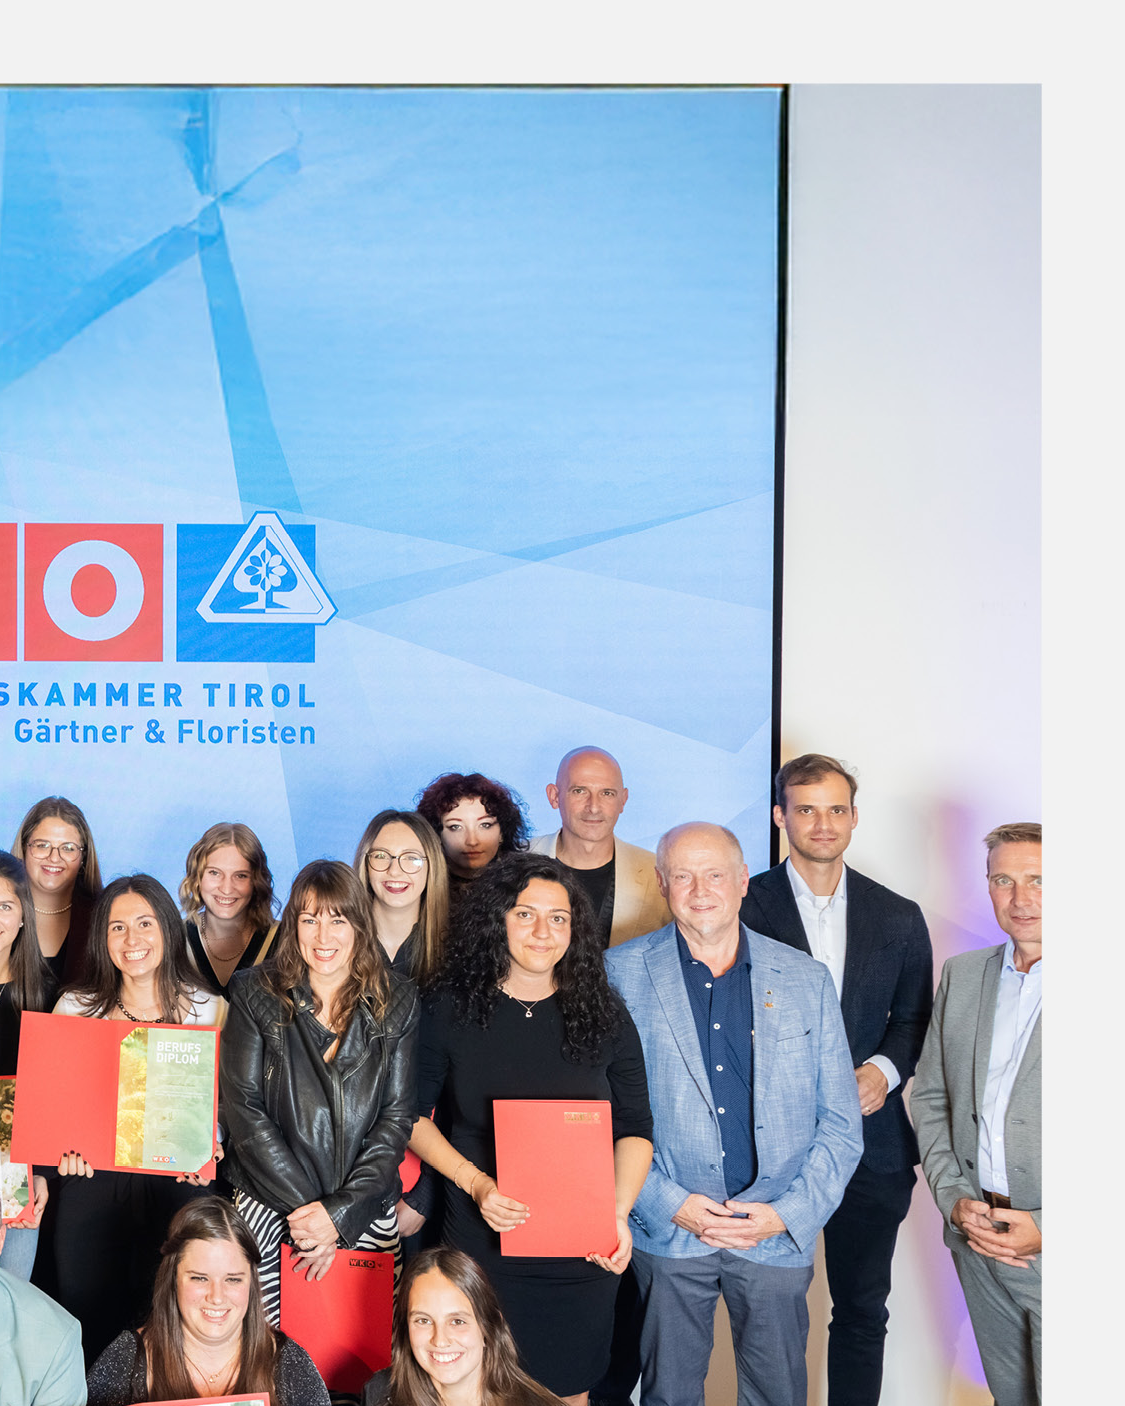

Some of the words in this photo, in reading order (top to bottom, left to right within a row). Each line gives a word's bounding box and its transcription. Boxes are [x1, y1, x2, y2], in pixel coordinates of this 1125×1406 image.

[203, 683, 316, 708] TIROL
[14, 719, 134, 744] Gärtner
[146, 719, 166, 744] &
[178, 719, 316, 745] Floristen
[157, 1041, 201, 1053] BERUFS
[157, 1053, 199, 1065] DIPLOM
[350, 1259, 374, 1268] WKO
